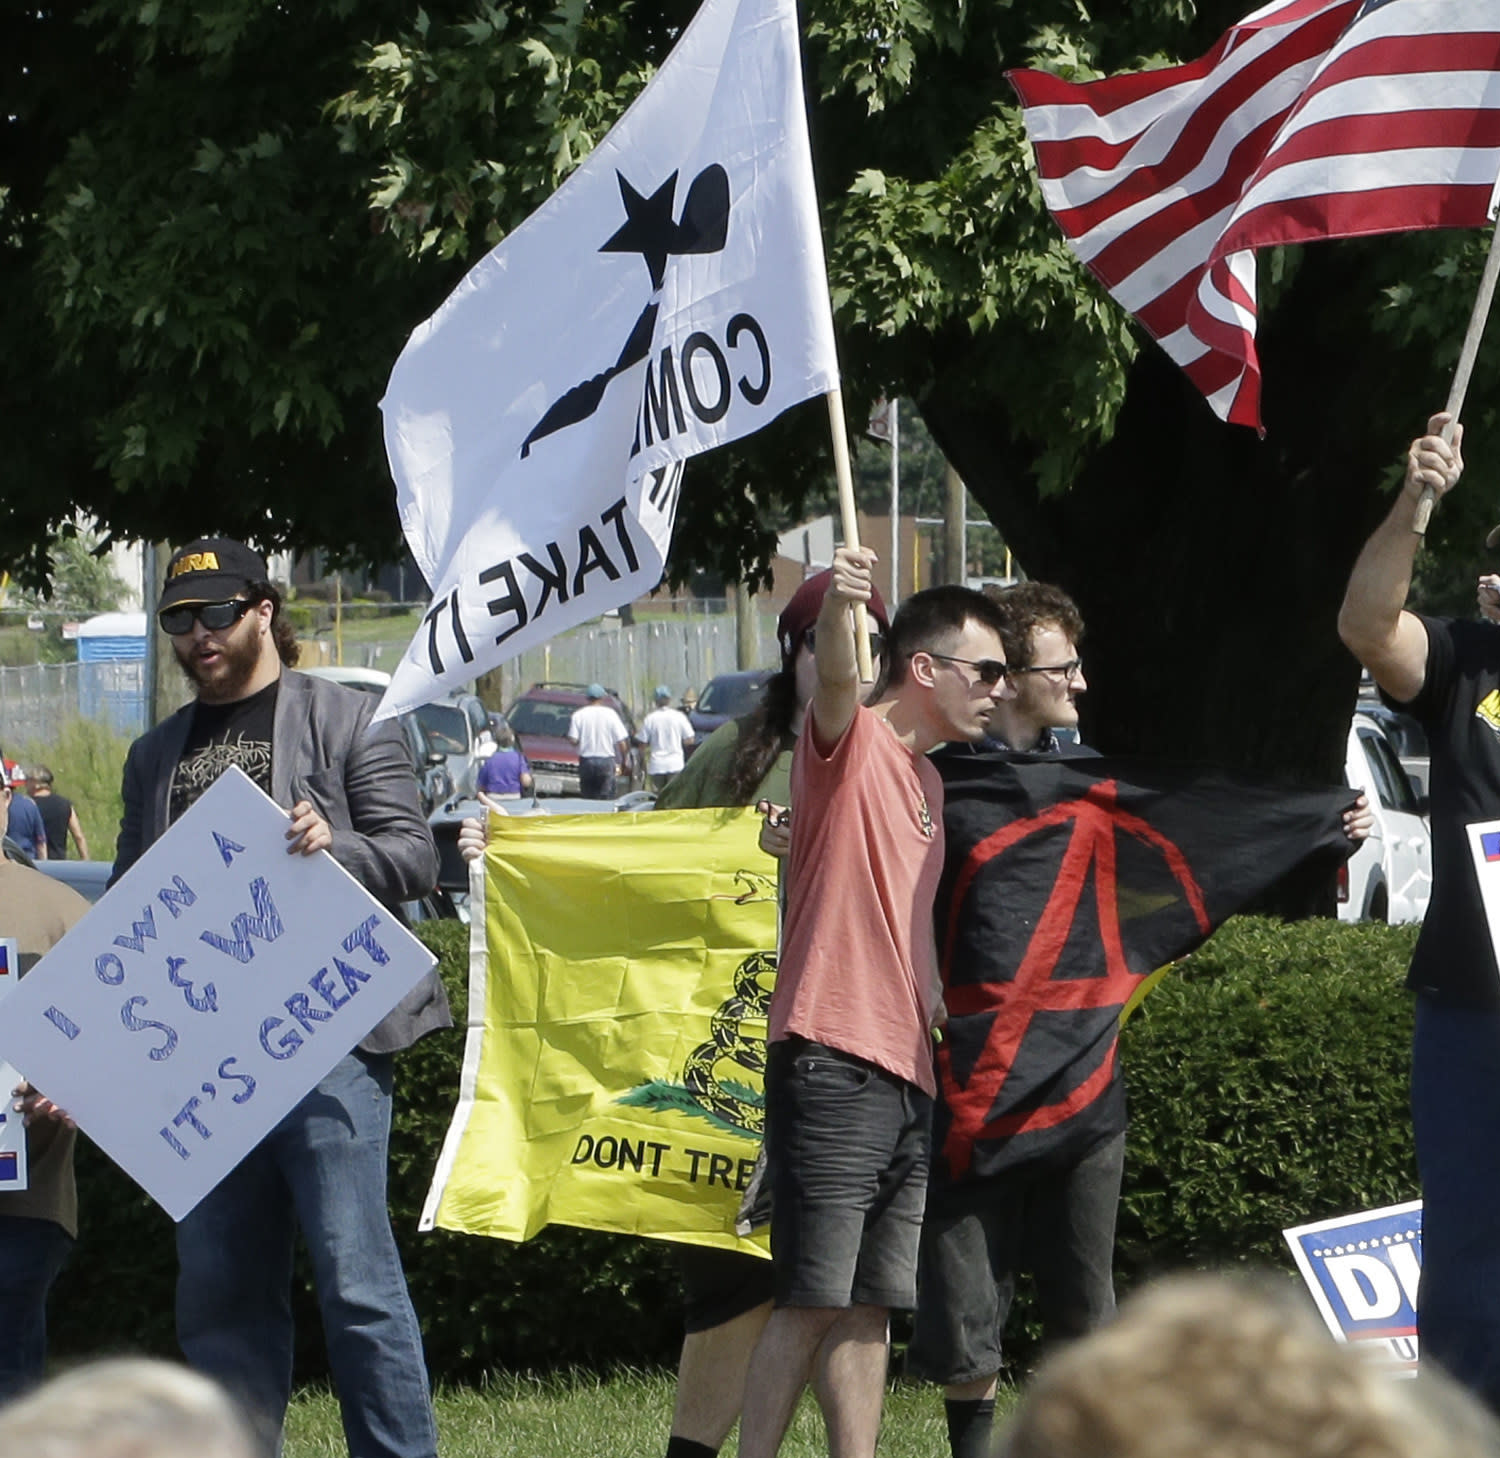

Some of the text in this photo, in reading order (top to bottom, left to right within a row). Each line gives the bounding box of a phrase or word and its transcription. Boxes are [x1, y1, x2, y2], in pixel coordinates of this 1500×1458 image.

[172, 552, 219, 578] NRA
[43, 1004, 81, 1040] I
[94, 874, 199, 986] OWN
[211, 830, 247, 868] A
[159, 913, 391, 1161] IT'S GREAT
[571, 1134, 671, 1177] DONT
